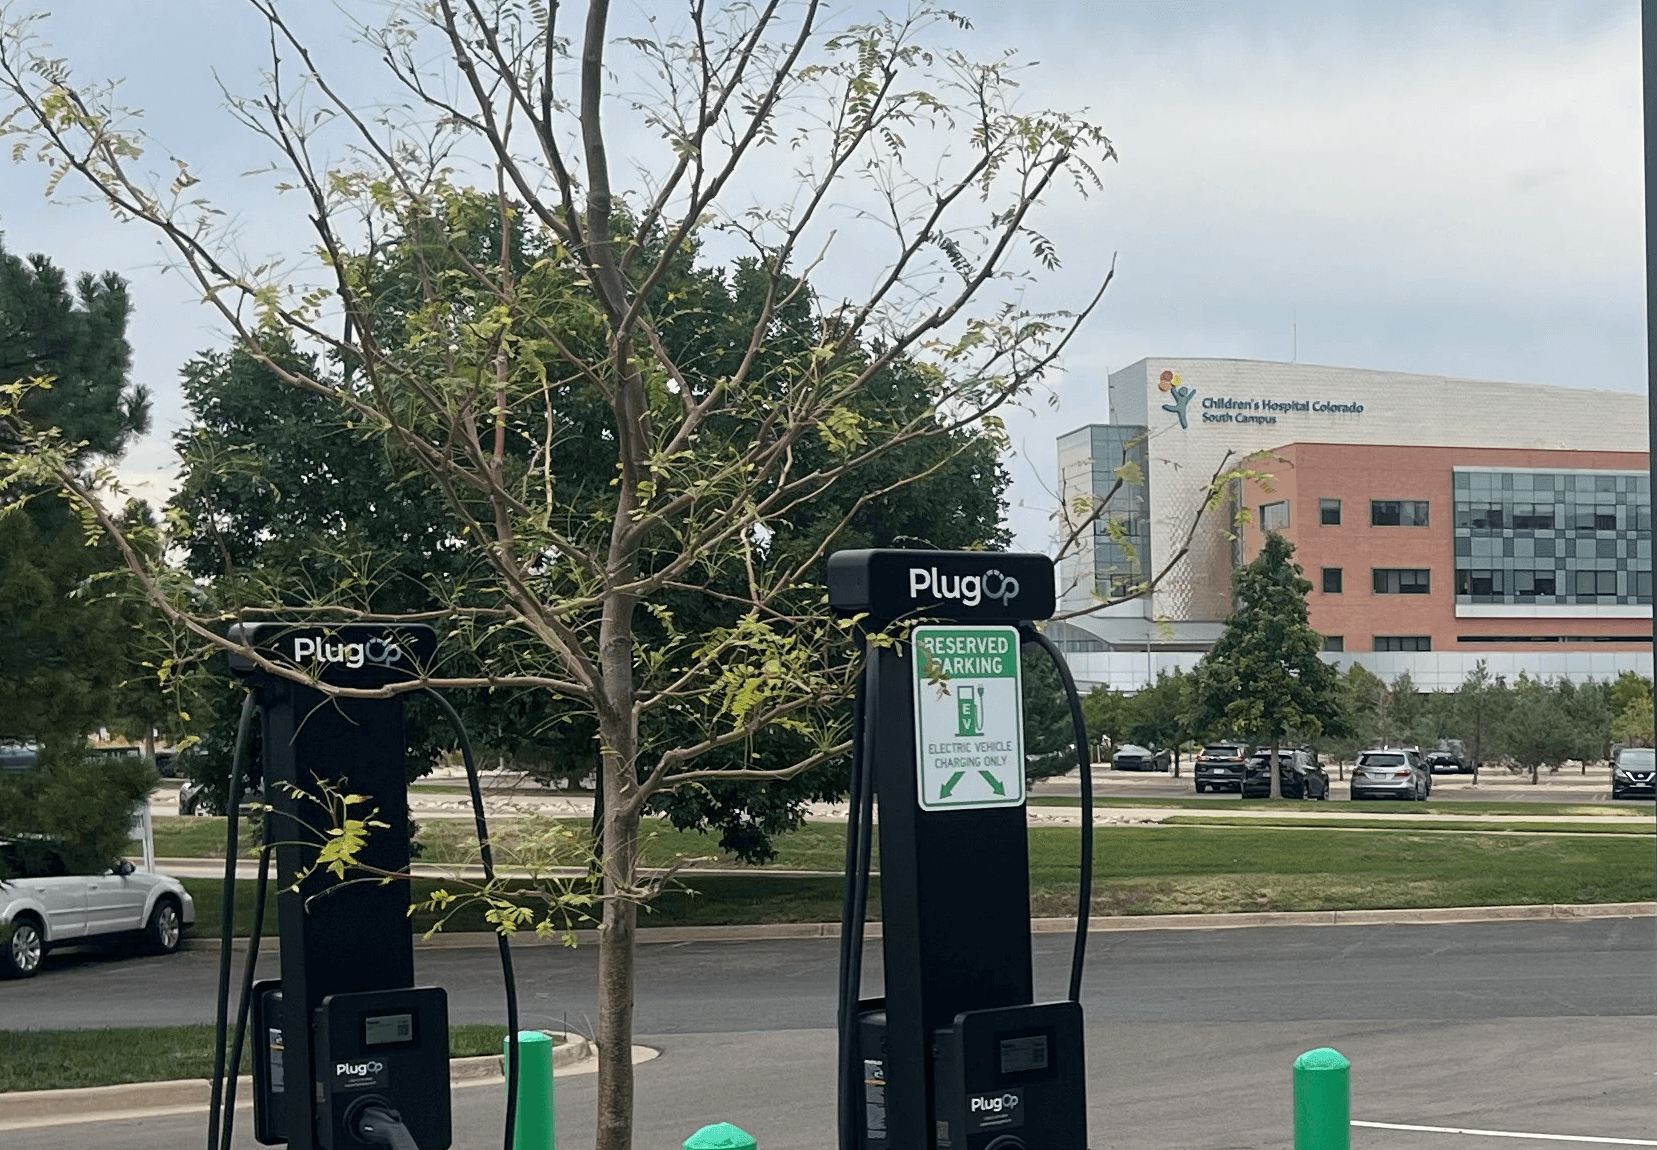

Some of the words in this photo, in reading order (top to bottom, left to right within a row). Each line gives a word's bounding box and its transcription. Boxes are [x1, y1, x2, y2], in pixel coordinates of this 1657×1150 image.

[1202, 397, 1260, 410] Children's
[1262, 399, 1310, 414] Hospital
[1311, 401, 1365, 414] Colorado
[1202, 412, 1233, 424] South
[1234, 413, 1277, 425] Campus
[923, 636, 1009, 655] RESERVED
[928, 742, 972, 755] ELECTRIC
[974, 740, 1013, 753] VEHICLE
[934, 758, 982, 769] CHARGING
[983, 755, 1008, 767] ONLY
